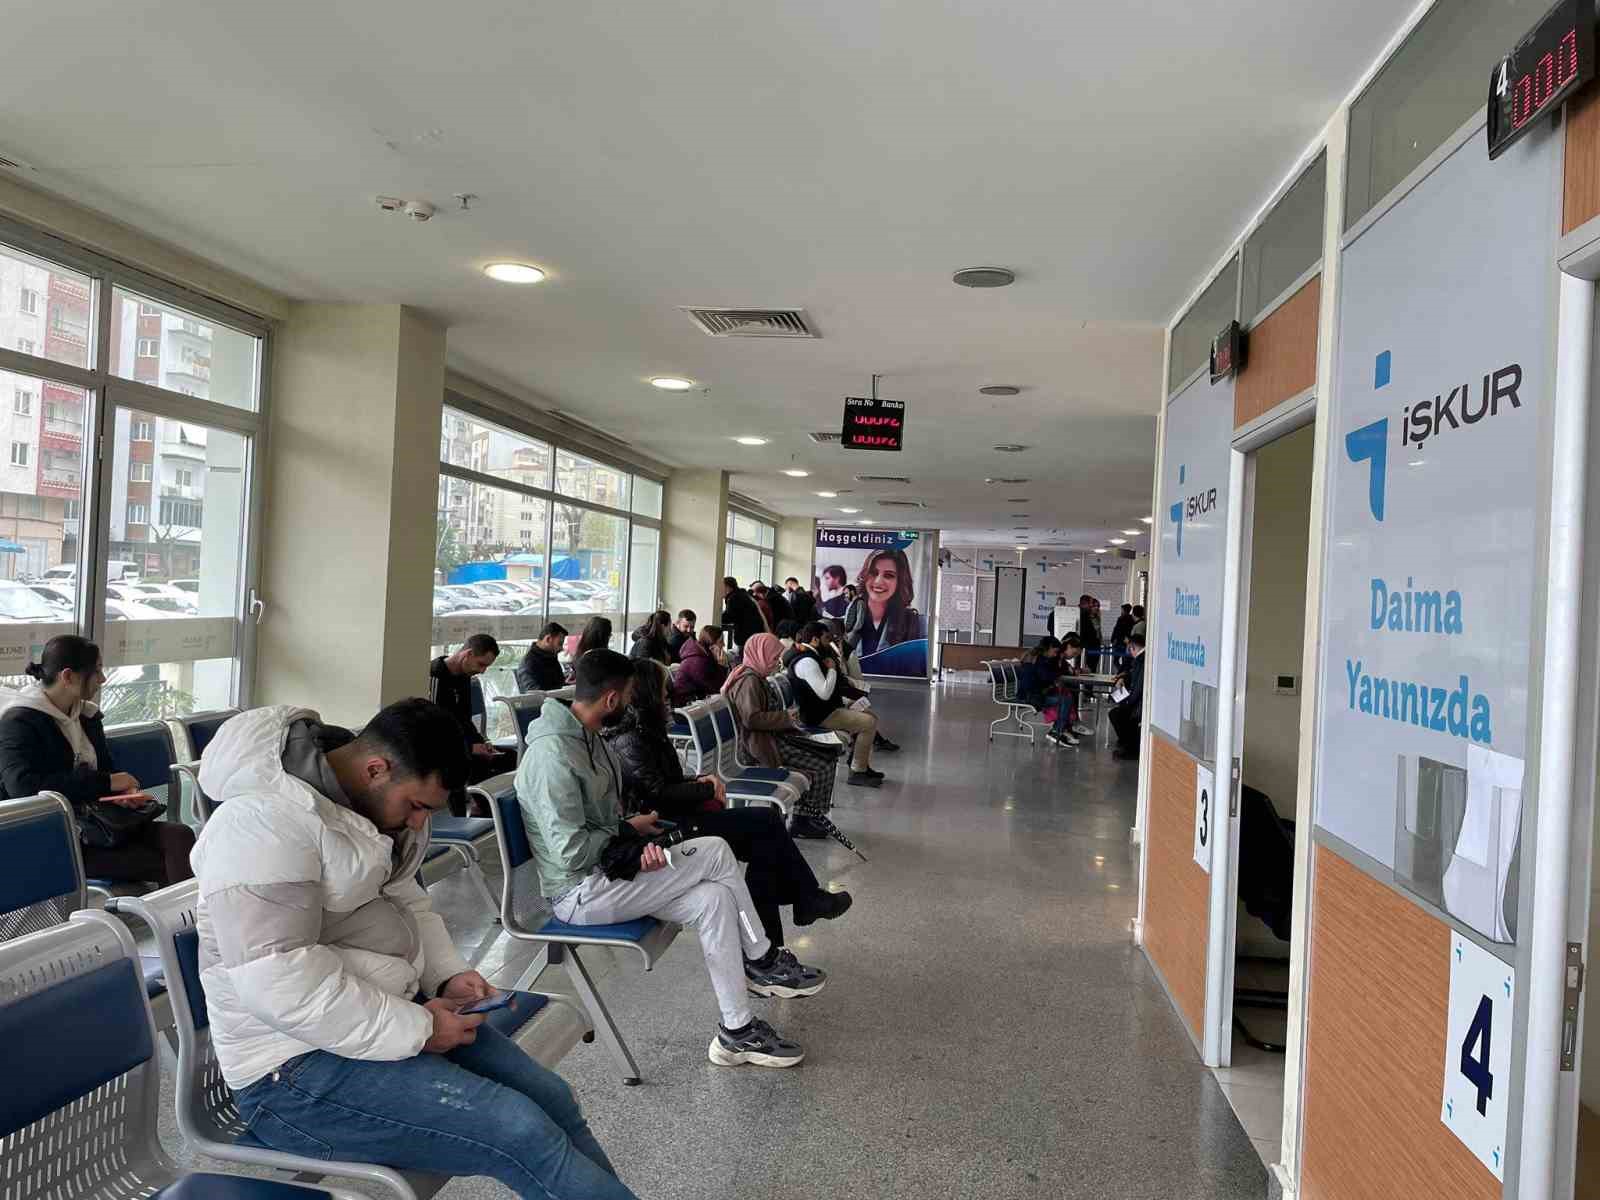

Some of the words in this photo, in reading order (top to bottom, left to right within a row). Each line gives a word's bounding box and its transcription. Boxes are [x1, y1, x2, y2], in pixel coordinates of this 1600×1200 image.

[1496, 60, 1508, 97] 4
[863, 399, 874, 407] No
[880, 400, 904, 409] Banko
[819, 529, 894, 545] Hoşgeldiniz
[1175, 587, 1201, 616] Daima
[1370, 576, 1463, 635] Daima
[1167, 631, 1206, 668] Yanınızda
[1346, 659, 1492, 743] Yanınızda
[1200, 788, 1209, 848] 3
[1460, 993, 1493, 1117] 4
